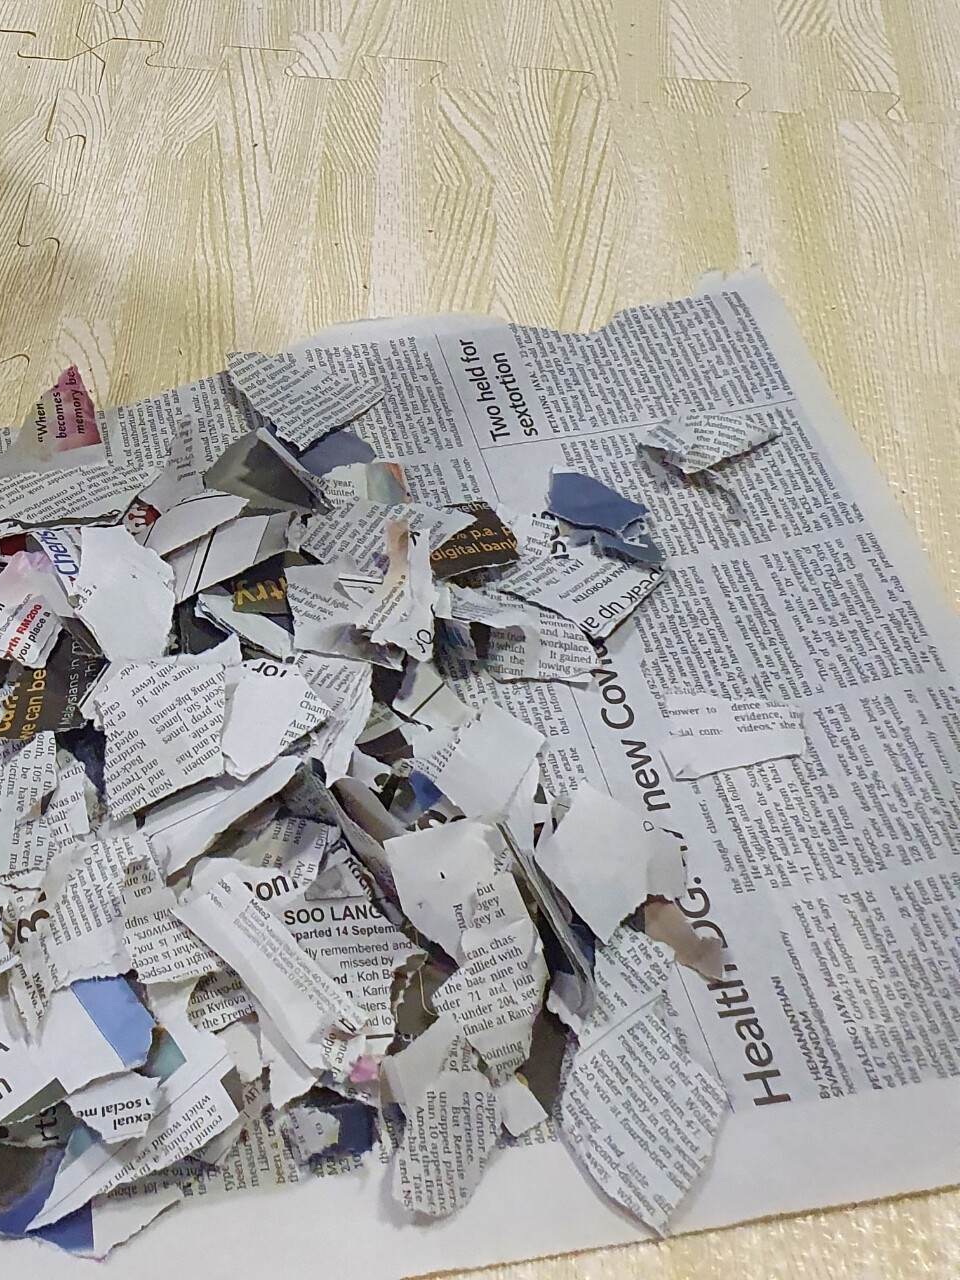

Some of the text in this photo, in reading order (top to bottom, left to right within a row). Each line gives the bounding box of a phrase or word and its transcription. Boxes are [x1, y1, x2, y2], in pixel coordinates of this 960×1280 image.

[459, 339, 510, 442] Two held for
[492, 352, 538, 437] sextortion
[530, 370, 544, 391] JAYA:
[52, 392, 67, 438] becomes
[68, 389, 85, 434] memory
[538, 395, 560, 434] PETALING
[470, 526, 498, 540] p.a.
[571, 576, 611, 604] PFORDTEN
[598, 567, 662, 619] peak up
[16, 604, 43, 635] RM200
[16, 610, 52, 662] you place a
[540, 637, 592, 653] workplace.
[20, 669, 46, 740] we can be
[148, 692, 190, 726] big-match
[812, 707, 838, 748] reported,
[181, 746, 220, 776] cumbent
[620, 738, 672, 812] new
[803, 735, 829, 777] Maldives
[699, 799, 744, 894] the Sungai cluster,
[726, 816, 763, 880] He reminded
[754, 817, 786, 860] provided.
[862, 826, 888, 871] Morocco.
[734, 852, 756, 893] Hisham.
[69, 882, 92, 932] Ragumaren
[284, 907, 325, 925] SOO
[320, 940, 412, 958] remembered and
[336, 926, 349, 937] 14
[352, 922, 400, 939] Septem
[816, 897, 858, 974] imported, says
[339, 956, 394, 969] missed by
[356, 970, 380, 982] Koh
[206, 994, 246, 1014] Kvitova
[791, 902, 882, 1091] PETALING JAYA: Malaysia record-
[837, 973, 863, 1020] Covid-19
[770, 976, 832, 1100] By HEMANANTHANI
[798, 1011, 844, 1097] SIVANANDAM
[105, 1098, 143, 1120] social
[152, 1094, 211, 1149] which would
[162, 1114, 206, 1154] clinching
